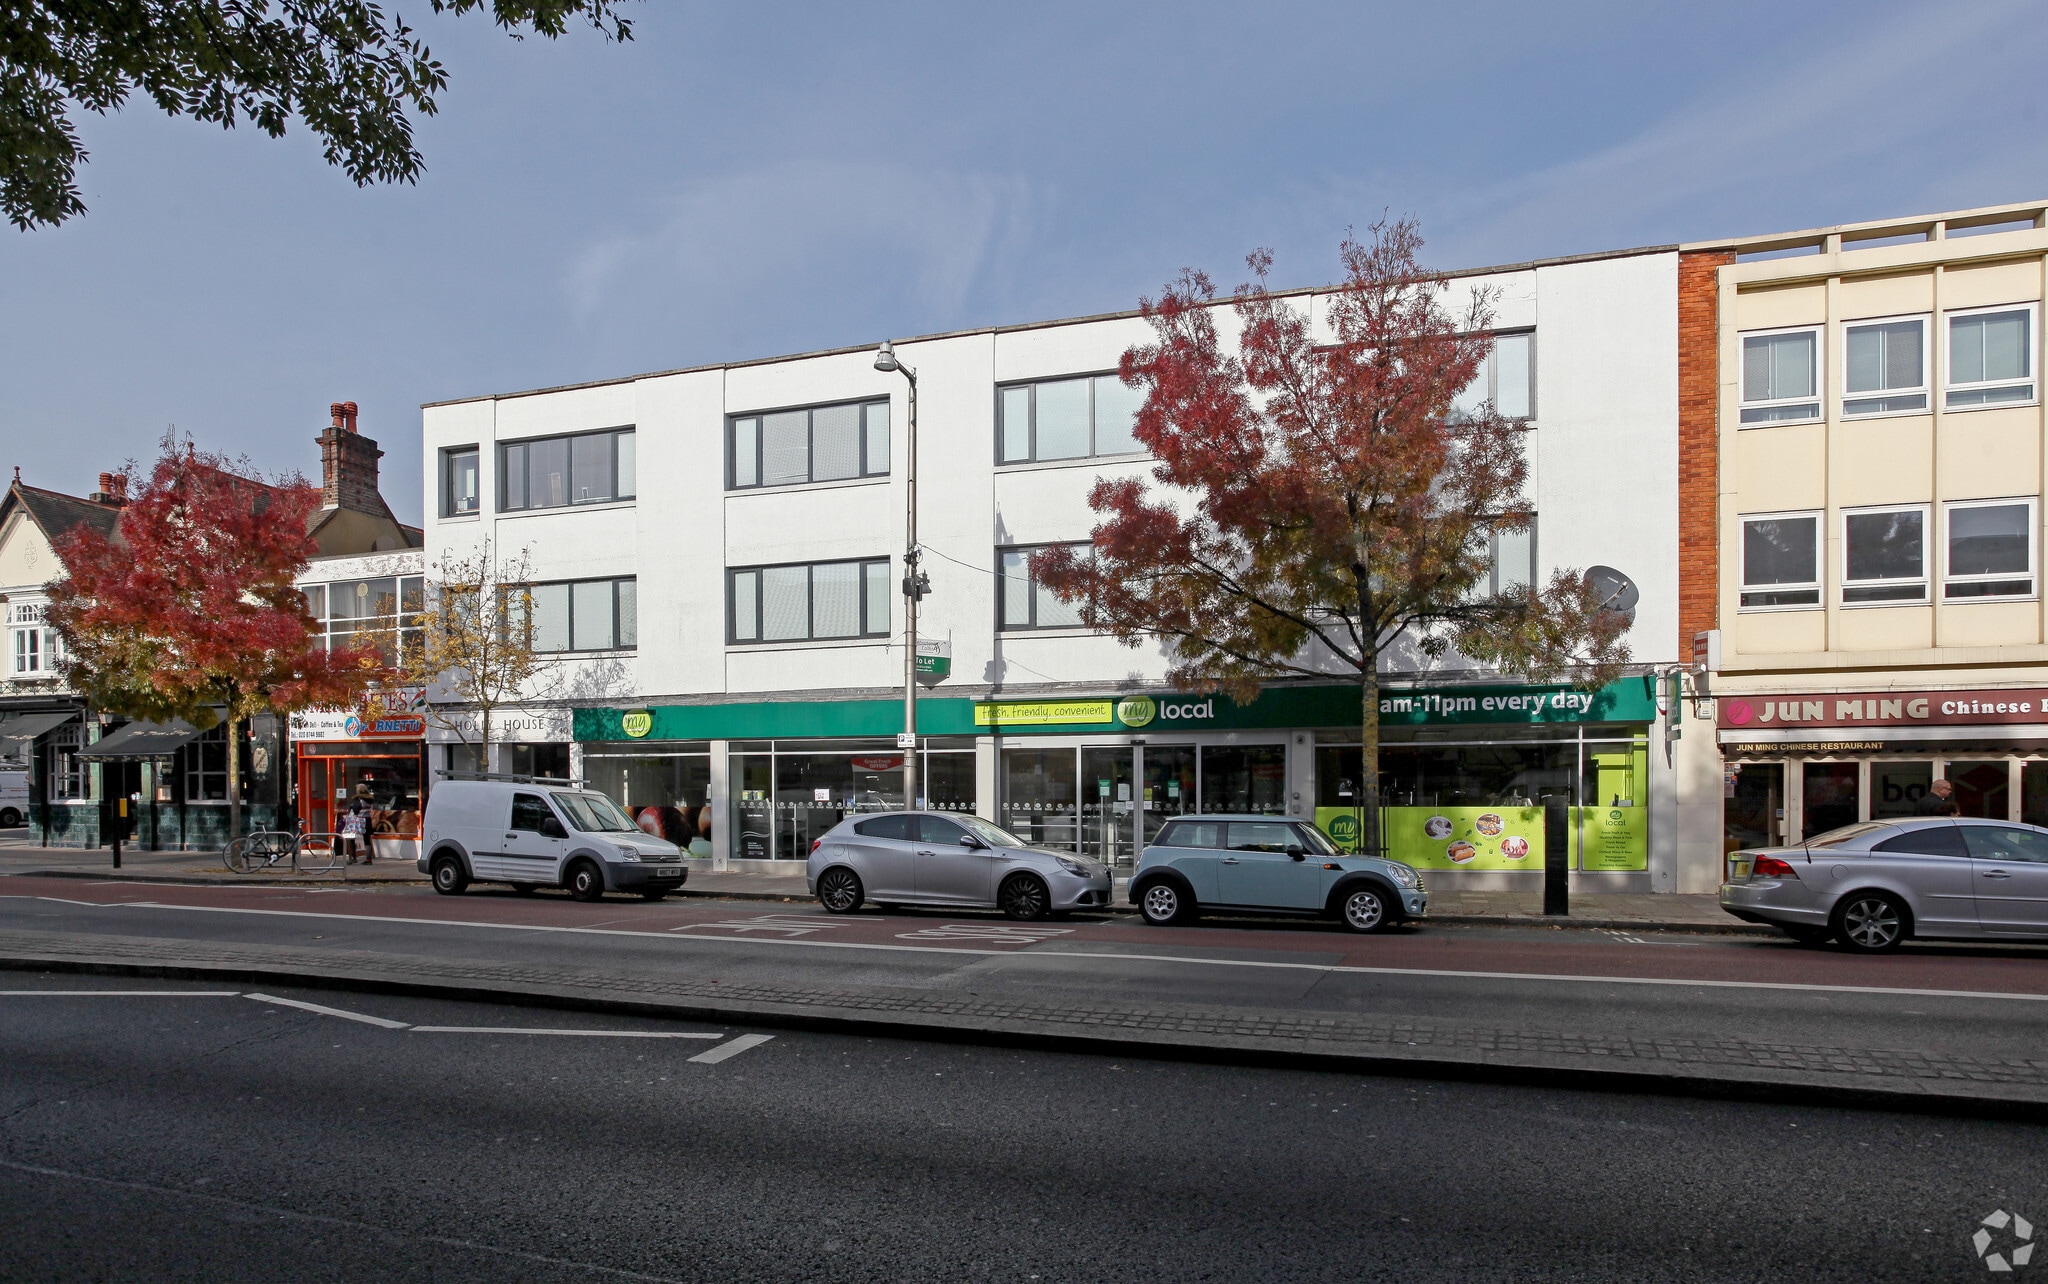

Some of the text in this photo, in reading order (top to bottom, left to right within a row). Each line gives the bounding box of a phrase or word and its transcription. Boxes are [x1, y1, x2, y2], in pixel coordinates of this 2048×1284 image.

[359, 692, 408, 713] BIES
[1124, 699, 1215, 722] my local
[1481, 692, 1546, 715] every
[1551, 689, 1594, 714] day
[1759, 701, 1824, 723] JUN
[1836, 699, 1930, 721] MING
[1941, 700, 2032, 715] Chinese
[982, 704, 1107, 721] fresh, friendly, convenient
[320, 721, 333, 729] Coffee
[361, 719, 420, 732] FORNETTI
[503, 718, 545, 731] HOUSE
[625, 715, 647, 733] my
[1736, 741, 1884, 751] JUN MING CHINESE RESTAURANT
[1334, 821, 1355, 839] my
